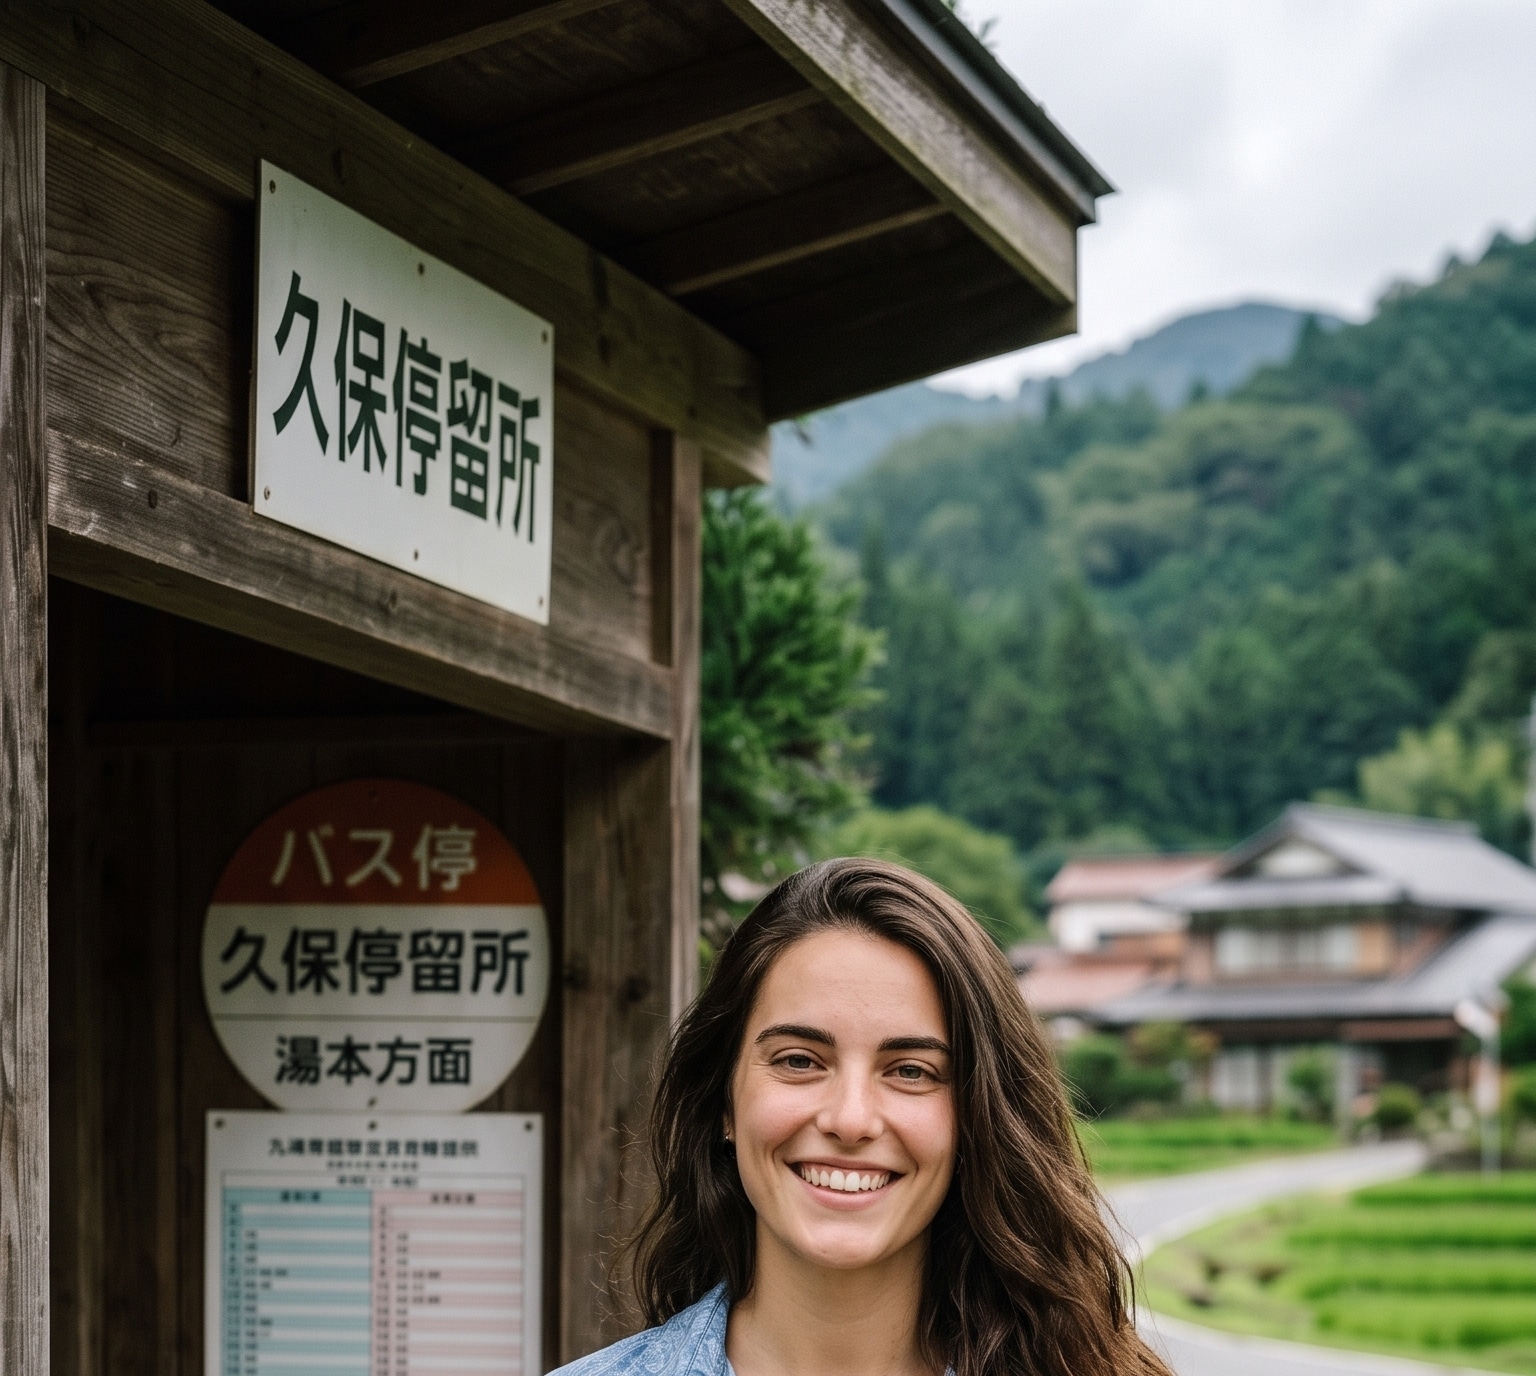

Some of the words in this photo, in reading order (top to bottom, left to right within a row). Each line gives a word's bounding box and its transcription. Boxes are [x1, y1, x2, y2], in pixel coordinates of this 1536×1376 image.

[273, 270, 540, 543] 久保停留所
[271, 824, 477, 891] バス停
[221, 927, 529, 995] 久保停留所
[275, 1036, 473, 1085] 湯本方面
